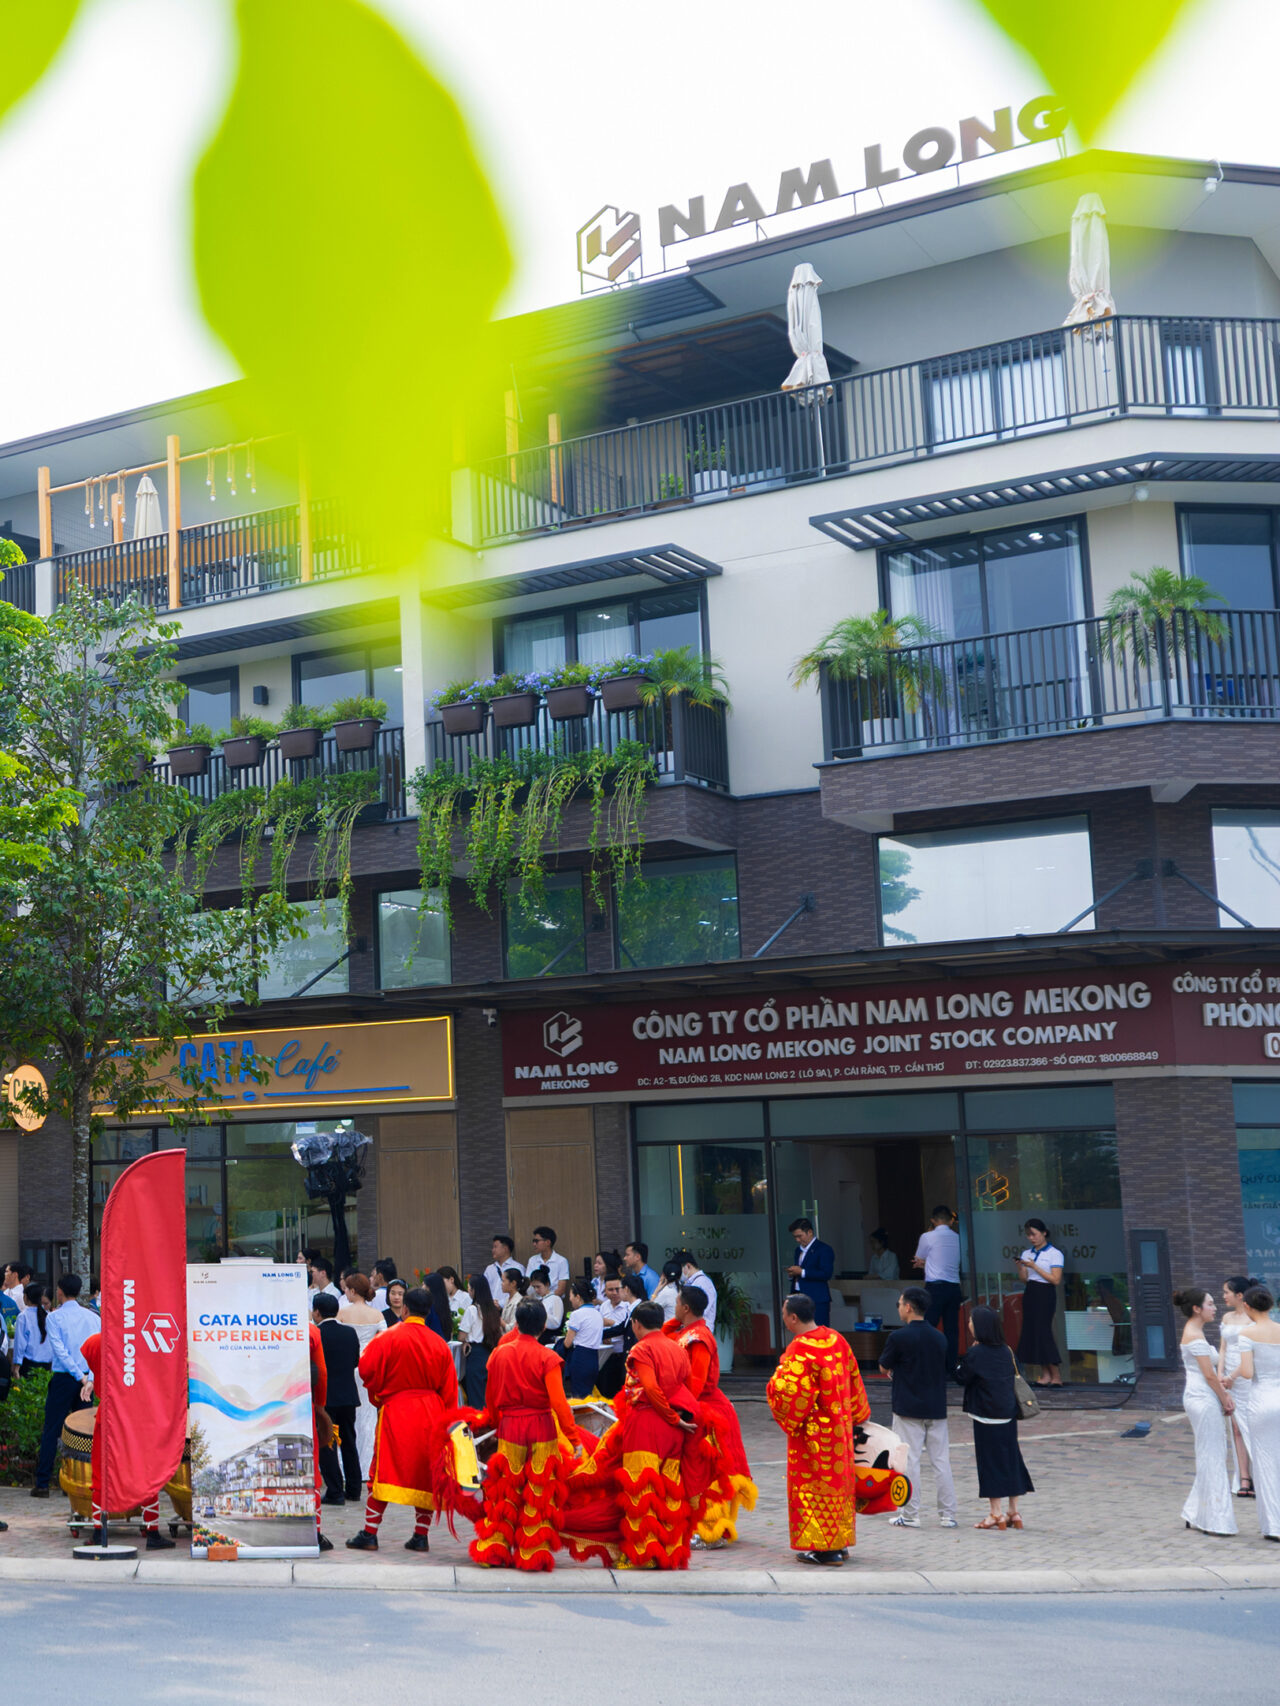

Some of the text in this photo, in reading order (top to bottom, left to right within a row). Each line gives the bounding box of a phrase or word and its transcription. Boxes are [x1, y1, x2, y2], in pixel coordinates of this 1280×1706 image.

[658, 94, 1070, 247] NAM LONG
[1172, 971, 1218, 993] CÔNG
[1219, 976, 1239, 993] TY
[1240, 968, 1263, 993] CỔ
[632, 981, 1151, 1040] CÔNG TY CỔ PHẦN NAM LONG MEKONG
[659, 1021, 1118, 1065] NAM LONG MEKONG JOINT STOCK COMPANY
[179, 1039, 341, 1090] CATA Café
[515, 1061, 619, 1079] NAM LONG
[724, 1073, 742, 1082] KDC
[743, 1072, 763, 1081] NAM
[765, 1070, 789, 1080] LONG
[889, 1063, 903, 1074] TP.
[926, 1061, 945, 1072] THƠ
[540, 1079, 590, 1091] MEKONG
[1072, 1245, 1097, 1259] 607
[199, 1313, 298, 1326] CATA HOUSE
[123, 1279, 136, 1387] NAM LONG
[192, 1329, 305, 1342] EXPERIENCE
